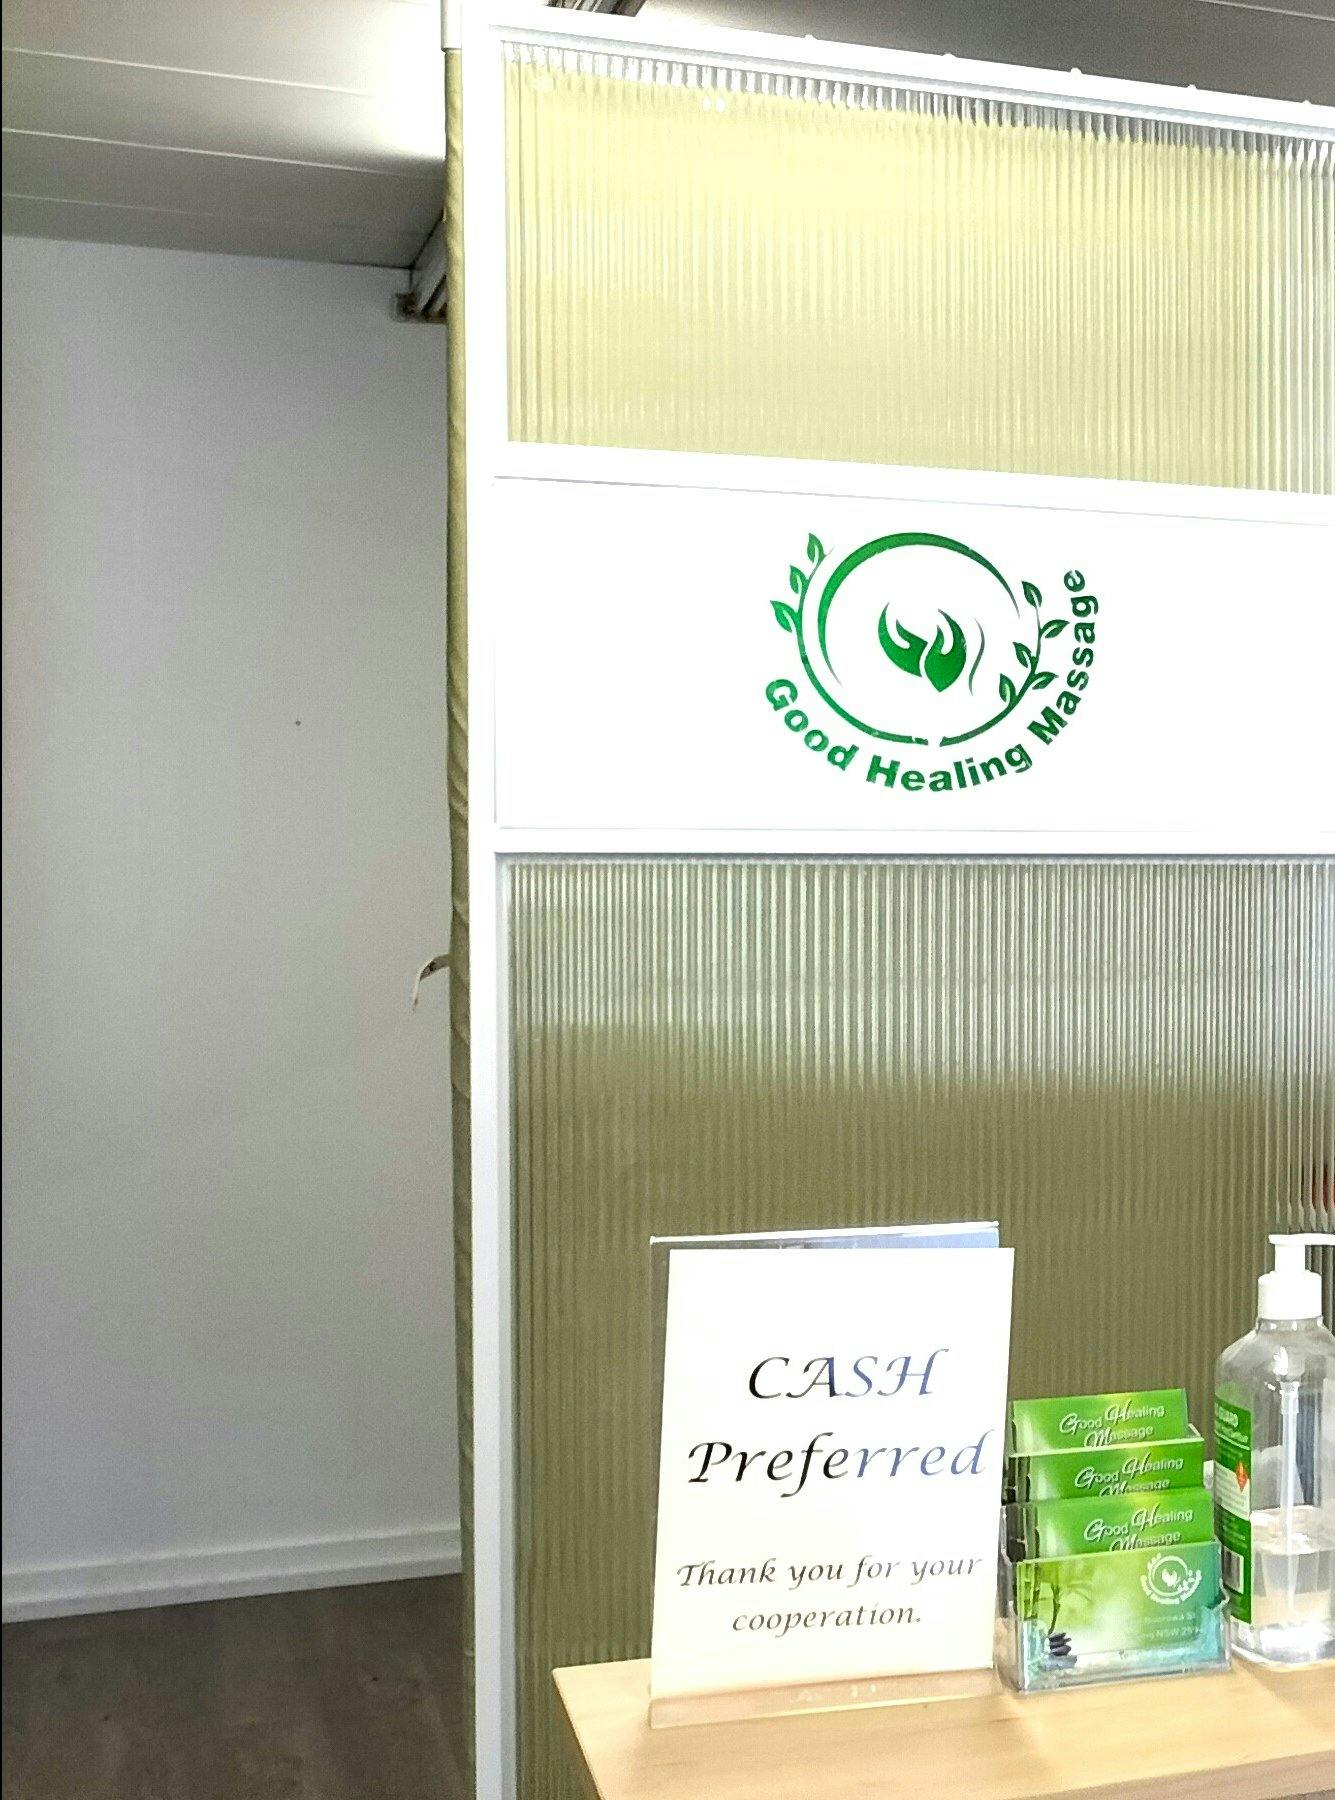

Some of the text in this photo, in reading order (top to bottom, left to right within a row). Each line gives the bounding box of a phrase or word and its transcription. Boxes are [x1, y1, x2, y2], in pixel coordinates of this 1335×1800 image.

[765, 570, 1099, 792] Good Healing Massage
[749, 1348, 949, 1400] CASH
[1059, 1400, 1165, 1435] Good Healing
[1084, 1426, 1154, 1447] Massage
[688, 1429, 995, 1498] Preferred
[1075, 1453, 1184, 1488] Good Healing
[1084, 1503, 1193, 1541] Good Healing
[676, 1554, 983, 1590] Thank you for your
[732, 1602, 921, 1639] cooperation.
